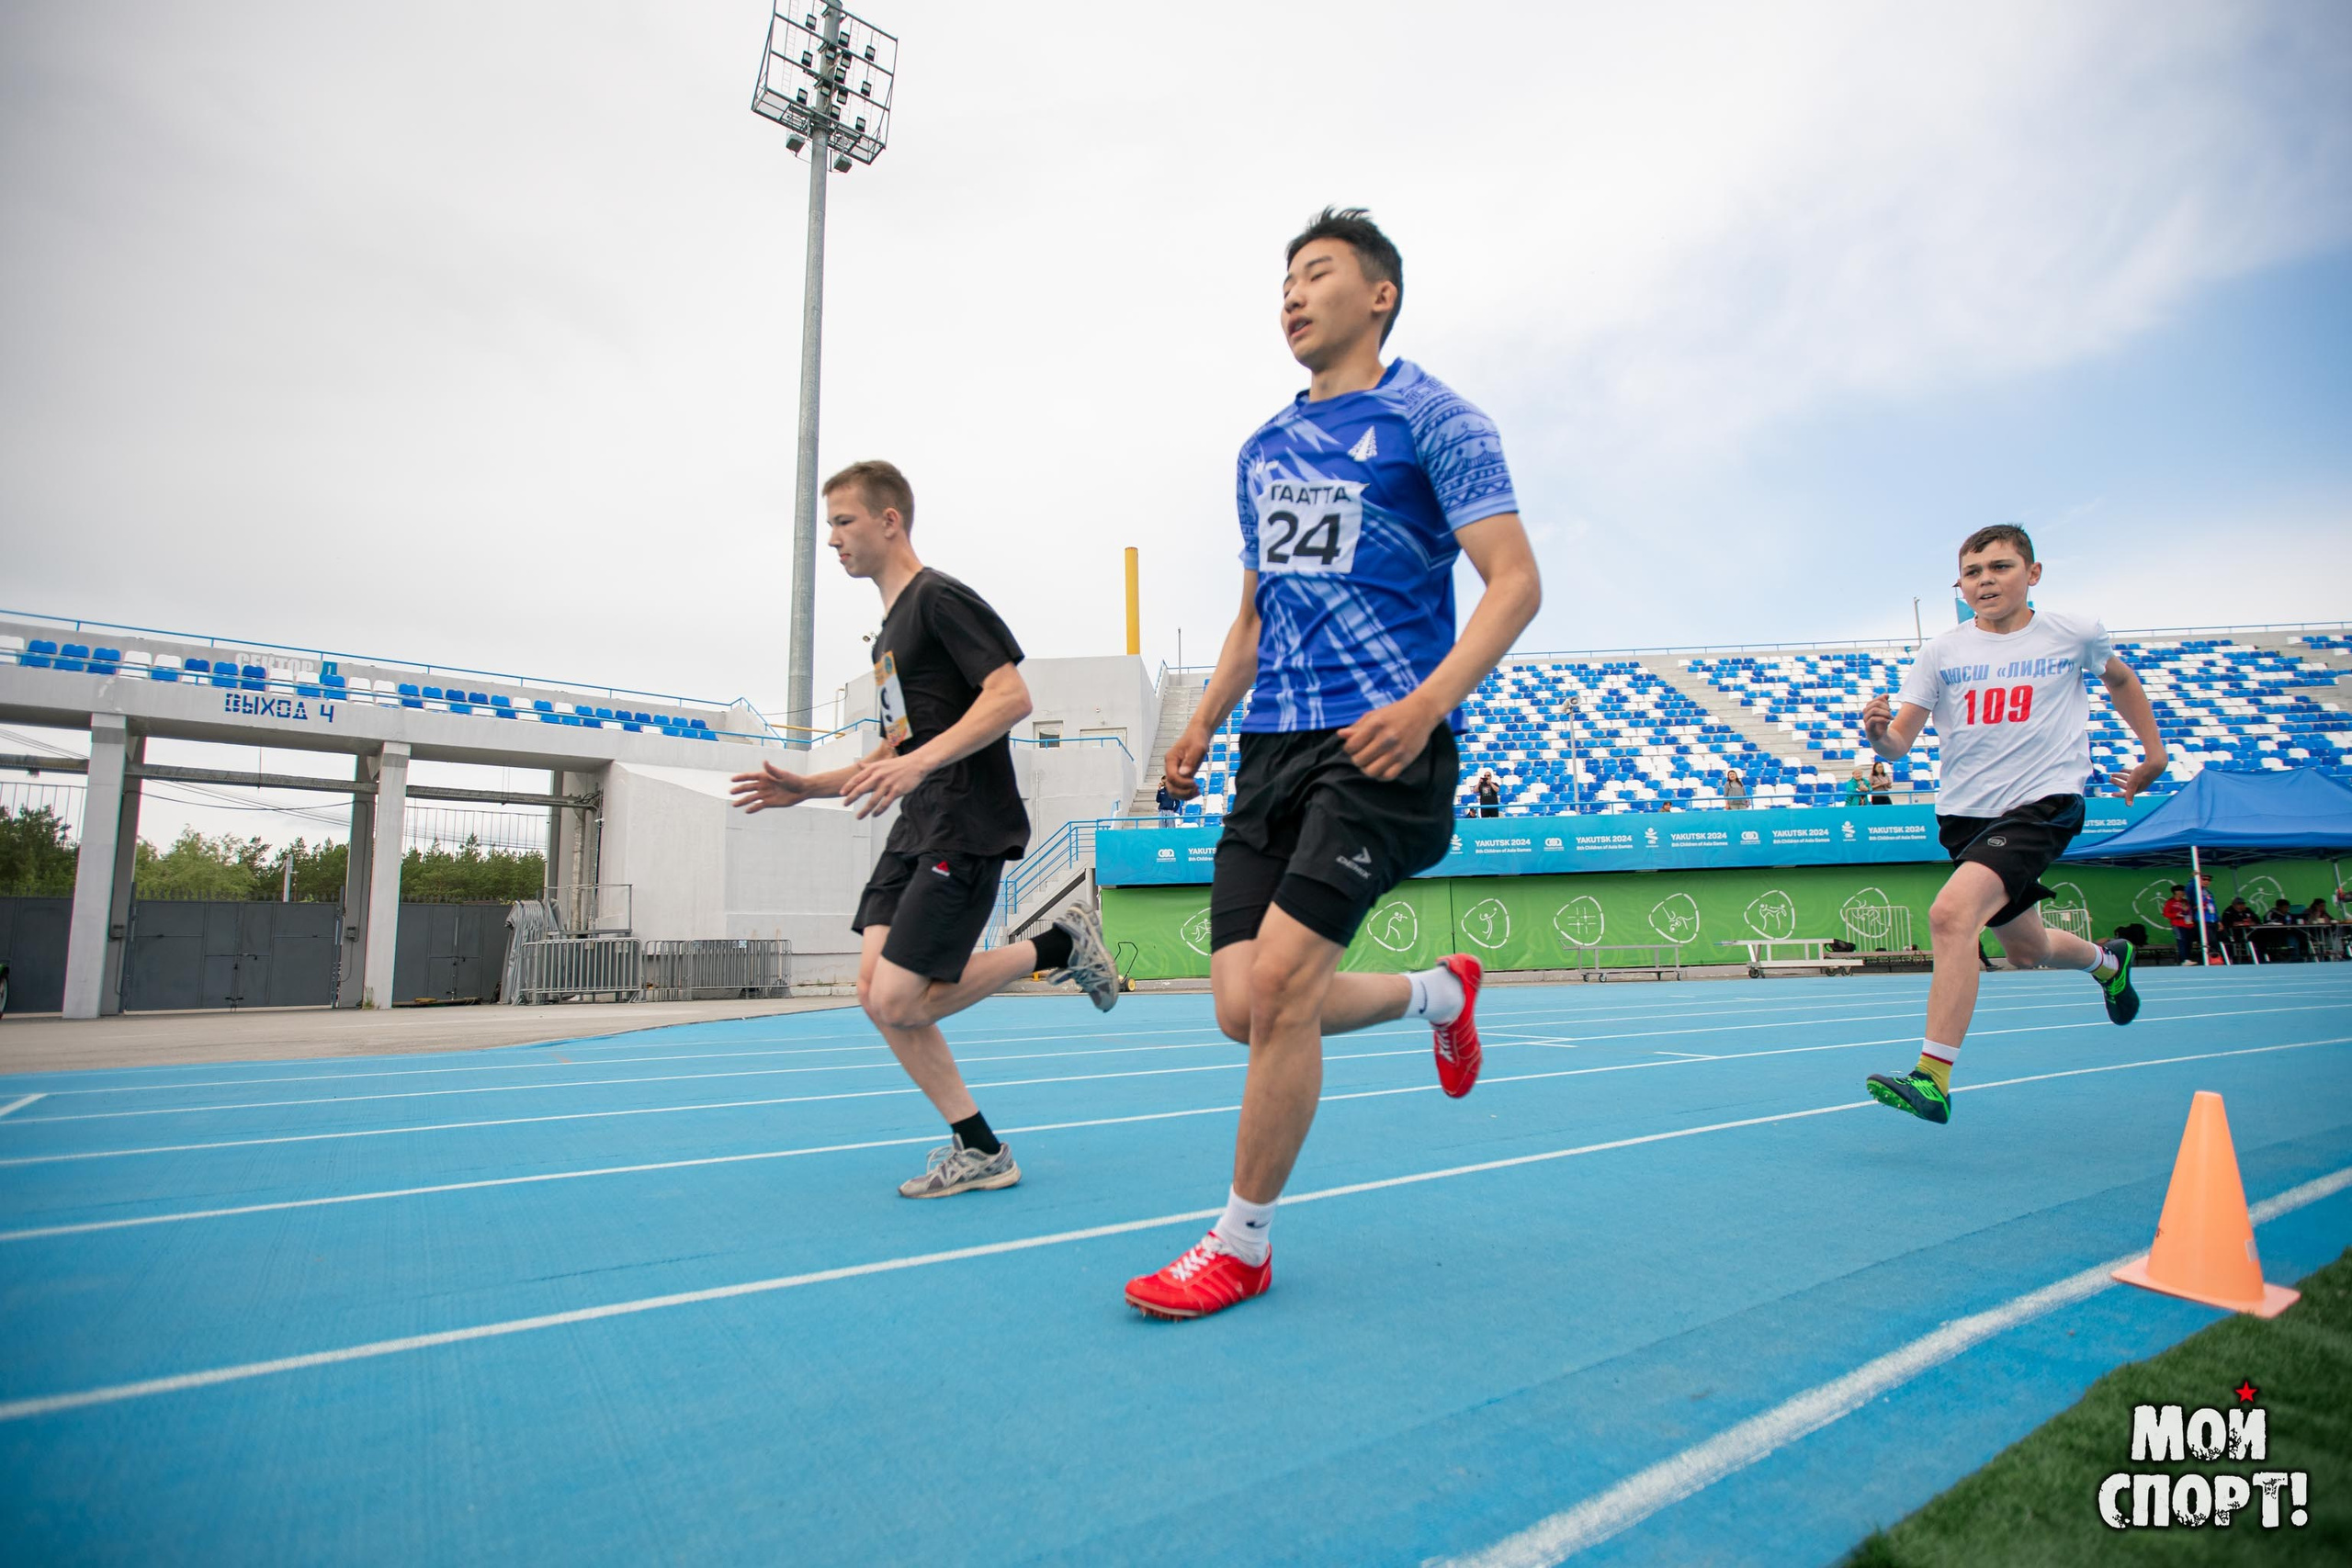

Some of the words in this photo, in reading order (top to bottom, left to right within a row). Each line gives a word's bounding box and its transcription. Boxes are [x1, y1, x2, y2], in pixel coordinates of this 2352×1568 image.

[1271, 485, 1351, 504] ГААТТА
[1267, 511, 1341, 566] 24
[225, 693, 308, 720] ВЫХОД
[320, 704, 334, 723] 4
[1964, 684, 2034, 725] 109
[1670, 832, 1706, 840] YAKUTSK
[1188, 847, 1217, 855] YAKUTS
